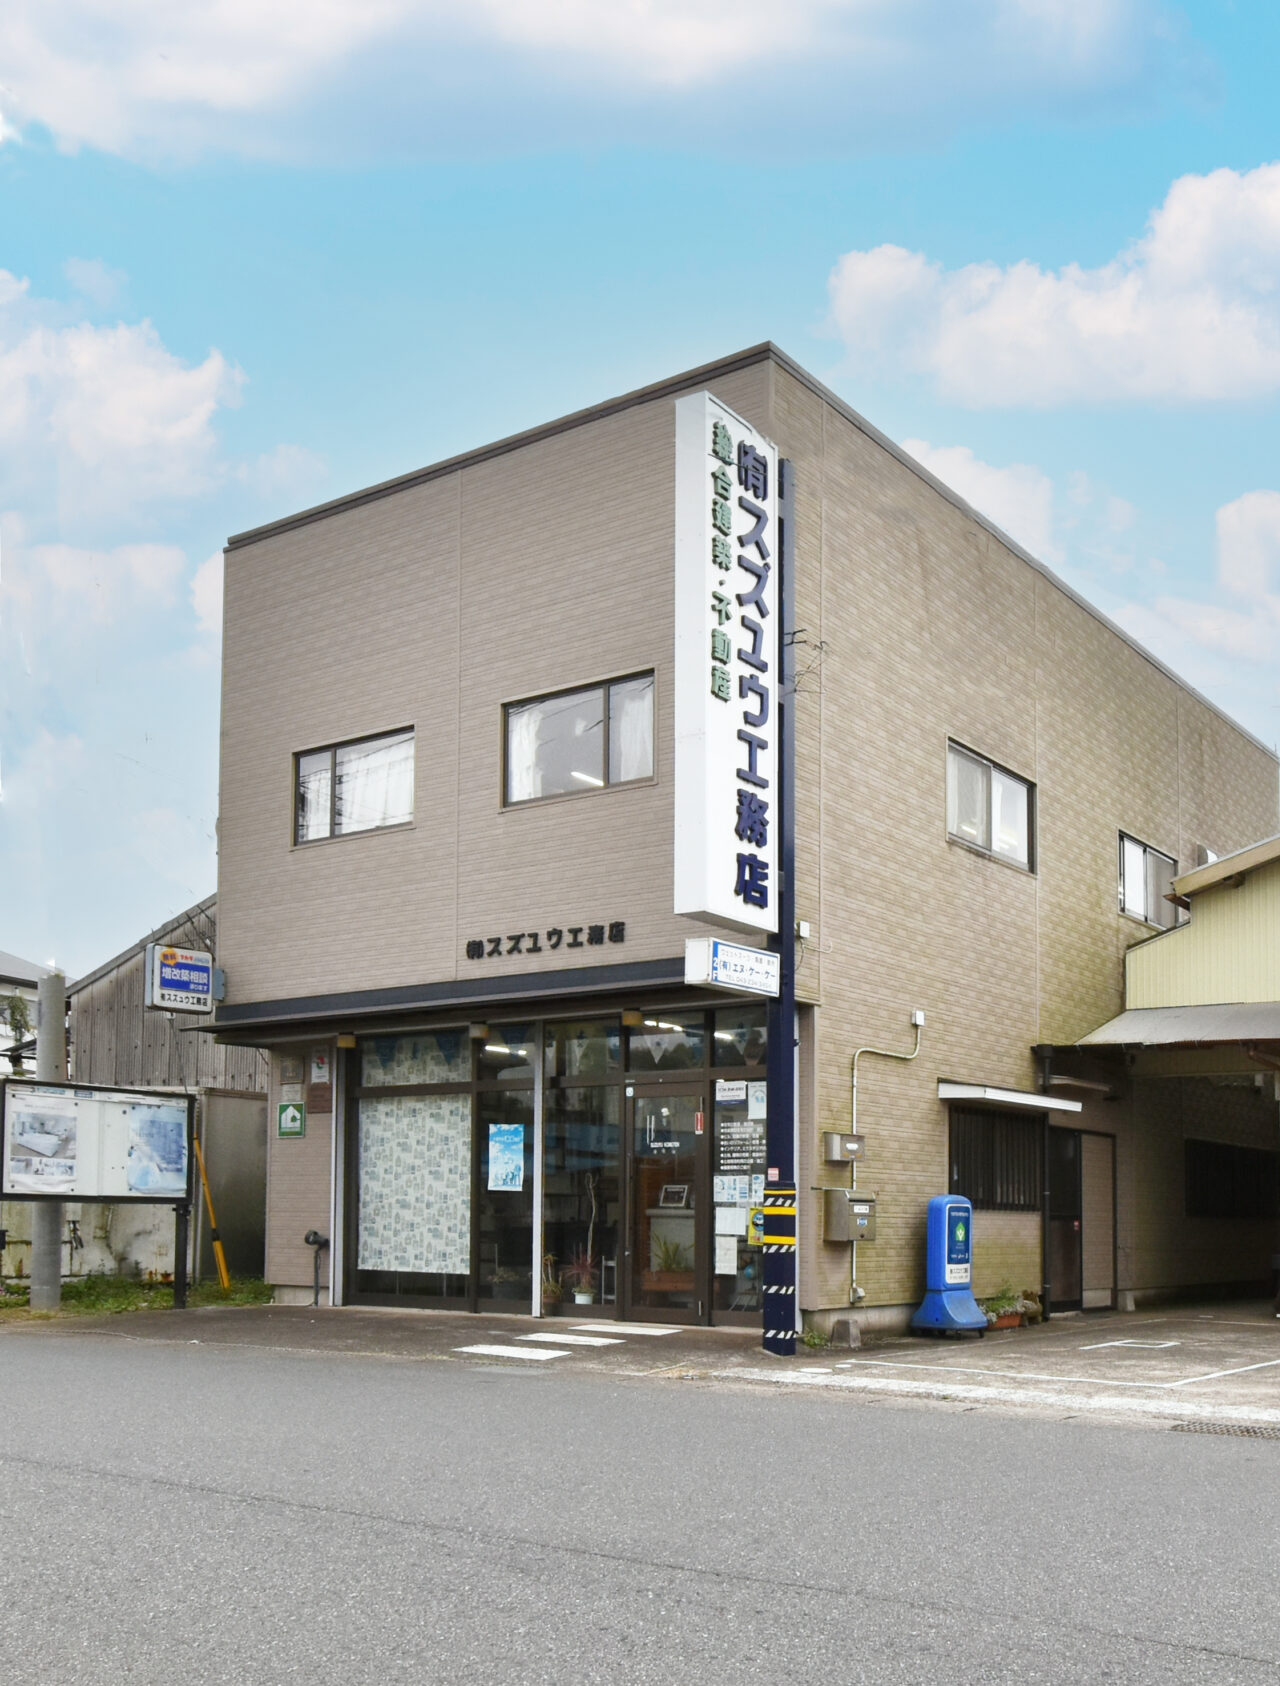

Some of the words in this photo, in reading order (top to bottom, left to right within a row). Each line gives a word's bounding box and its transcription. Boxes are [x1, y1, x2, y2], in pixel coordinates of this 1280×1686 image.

[162, 966, 208, 985] 増改築相談
